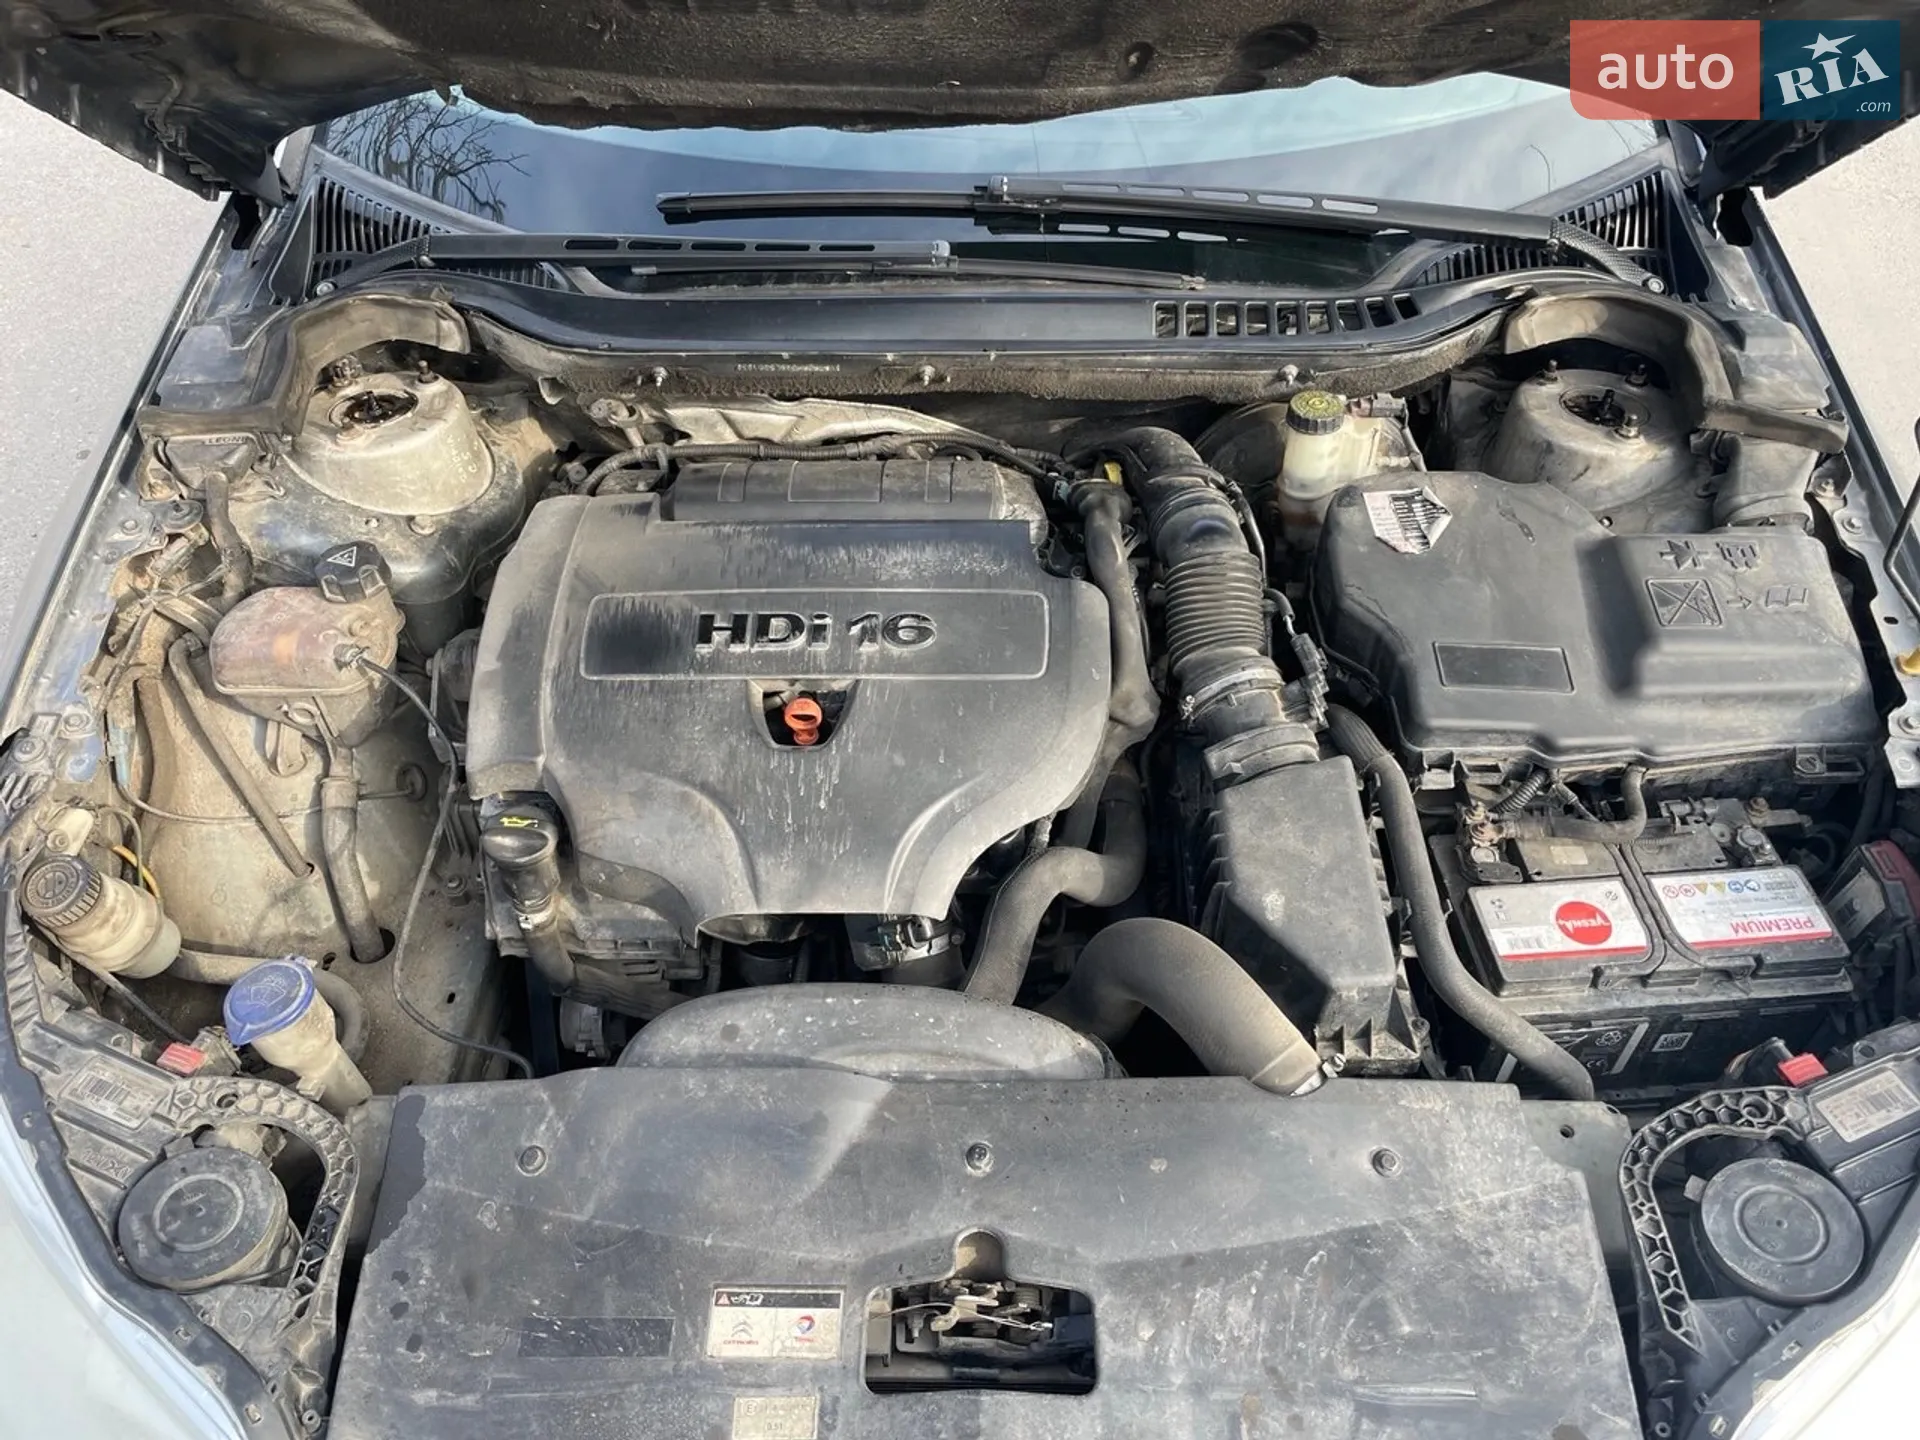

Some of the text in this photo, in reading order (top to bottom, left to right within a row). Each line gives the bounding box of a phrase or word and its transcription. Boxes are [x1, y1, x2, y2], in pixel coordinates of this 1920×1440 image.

[694, 611, 937, 651] HDi 16
[1730, 916, 1815, 935] PREMIUM
